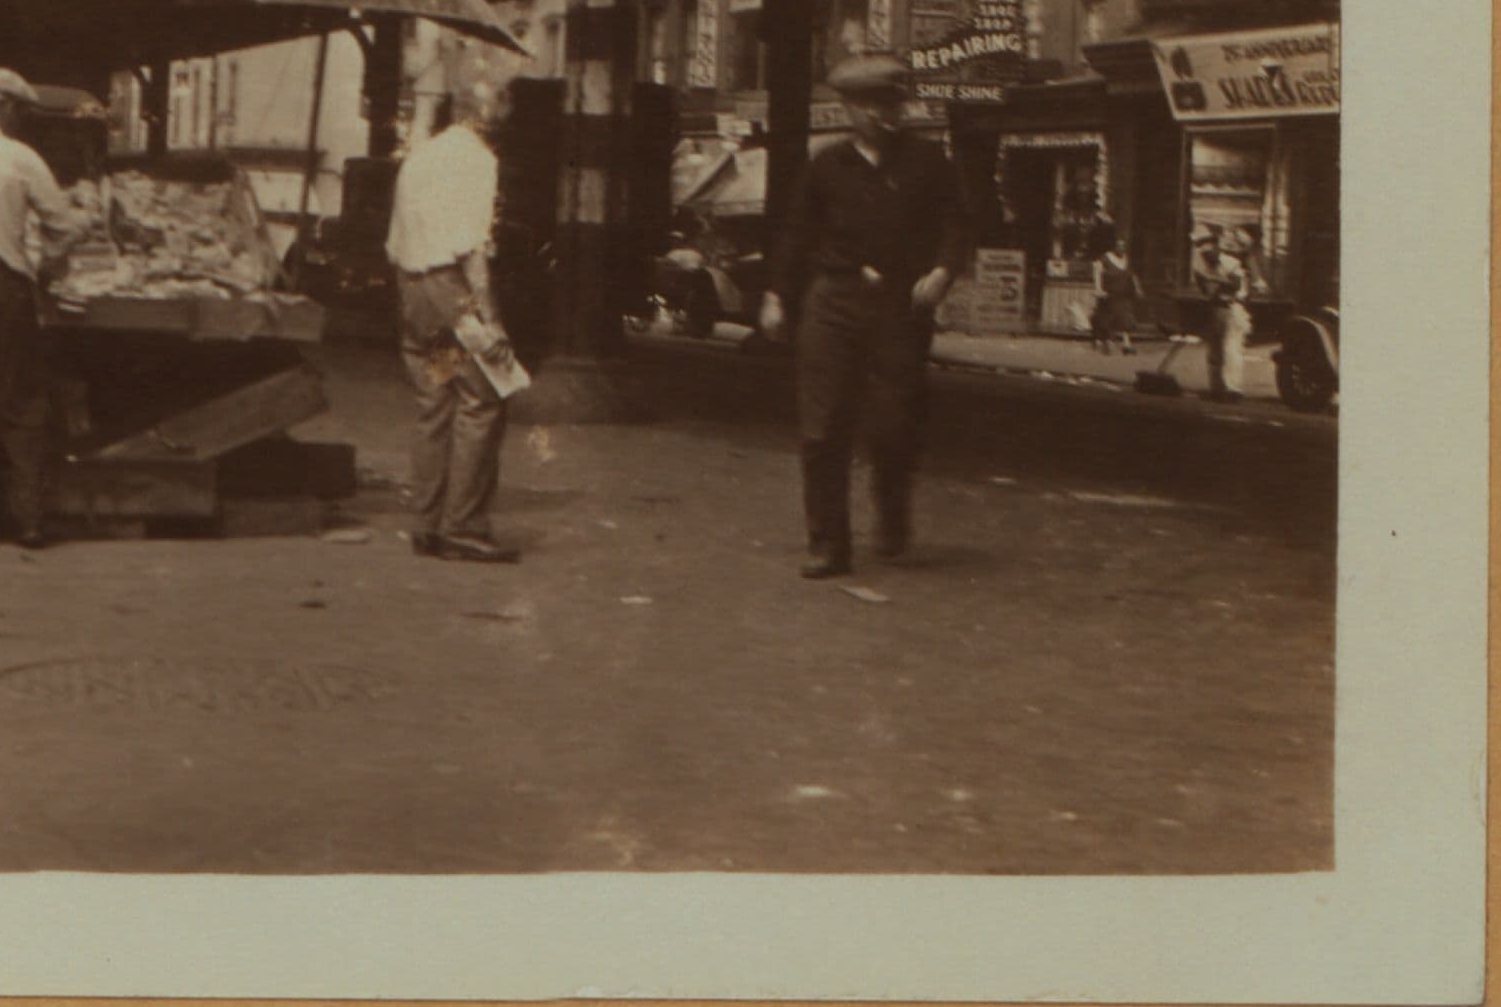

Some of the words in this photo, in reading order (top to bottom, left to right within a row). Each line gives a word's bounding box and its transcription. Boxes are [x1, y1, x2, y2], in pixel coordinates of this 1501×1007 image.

[912, 34, 1021, 69] REPAIRING
[916, 84, 954, 98] SHOE
[958, 86, 1003, 101] SHINE
